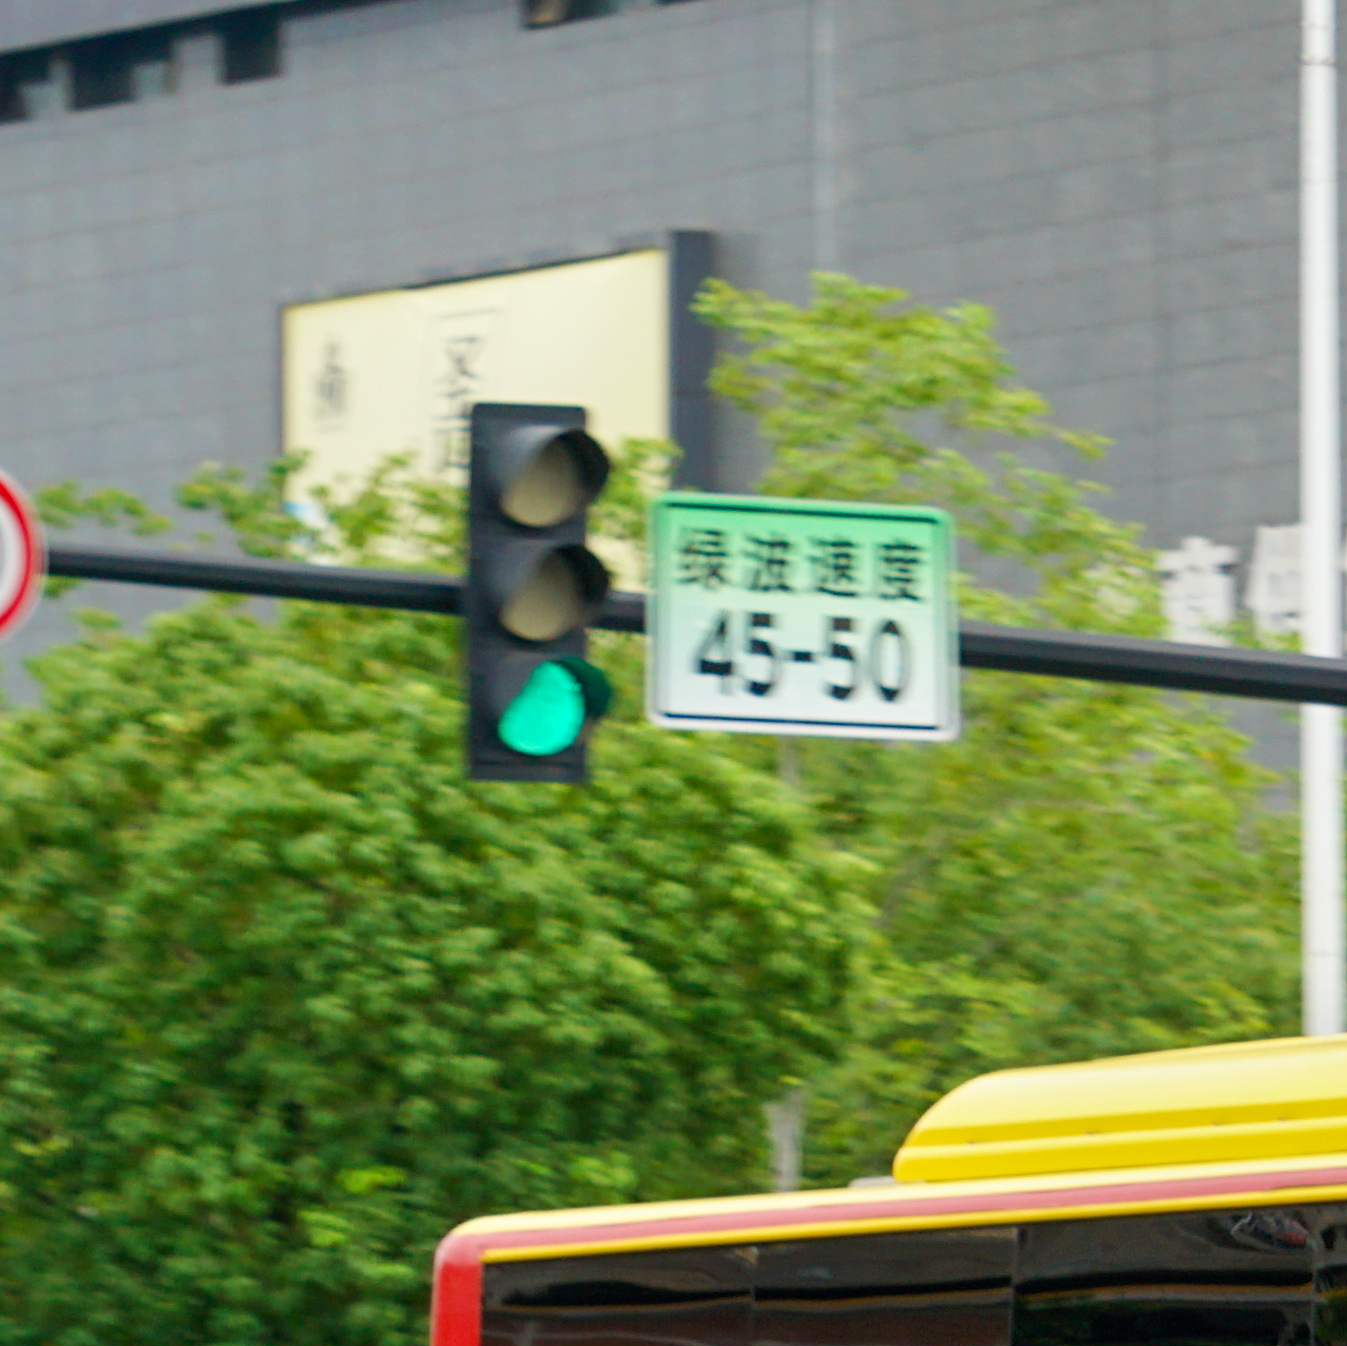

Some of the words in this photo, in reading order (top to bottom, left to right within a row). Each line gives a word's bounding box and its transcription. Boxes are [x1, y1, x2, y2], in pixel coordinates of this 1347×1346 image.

[676, 527, 922, 602] 绿波速度
[690, 609, 911, 703] 45-50
